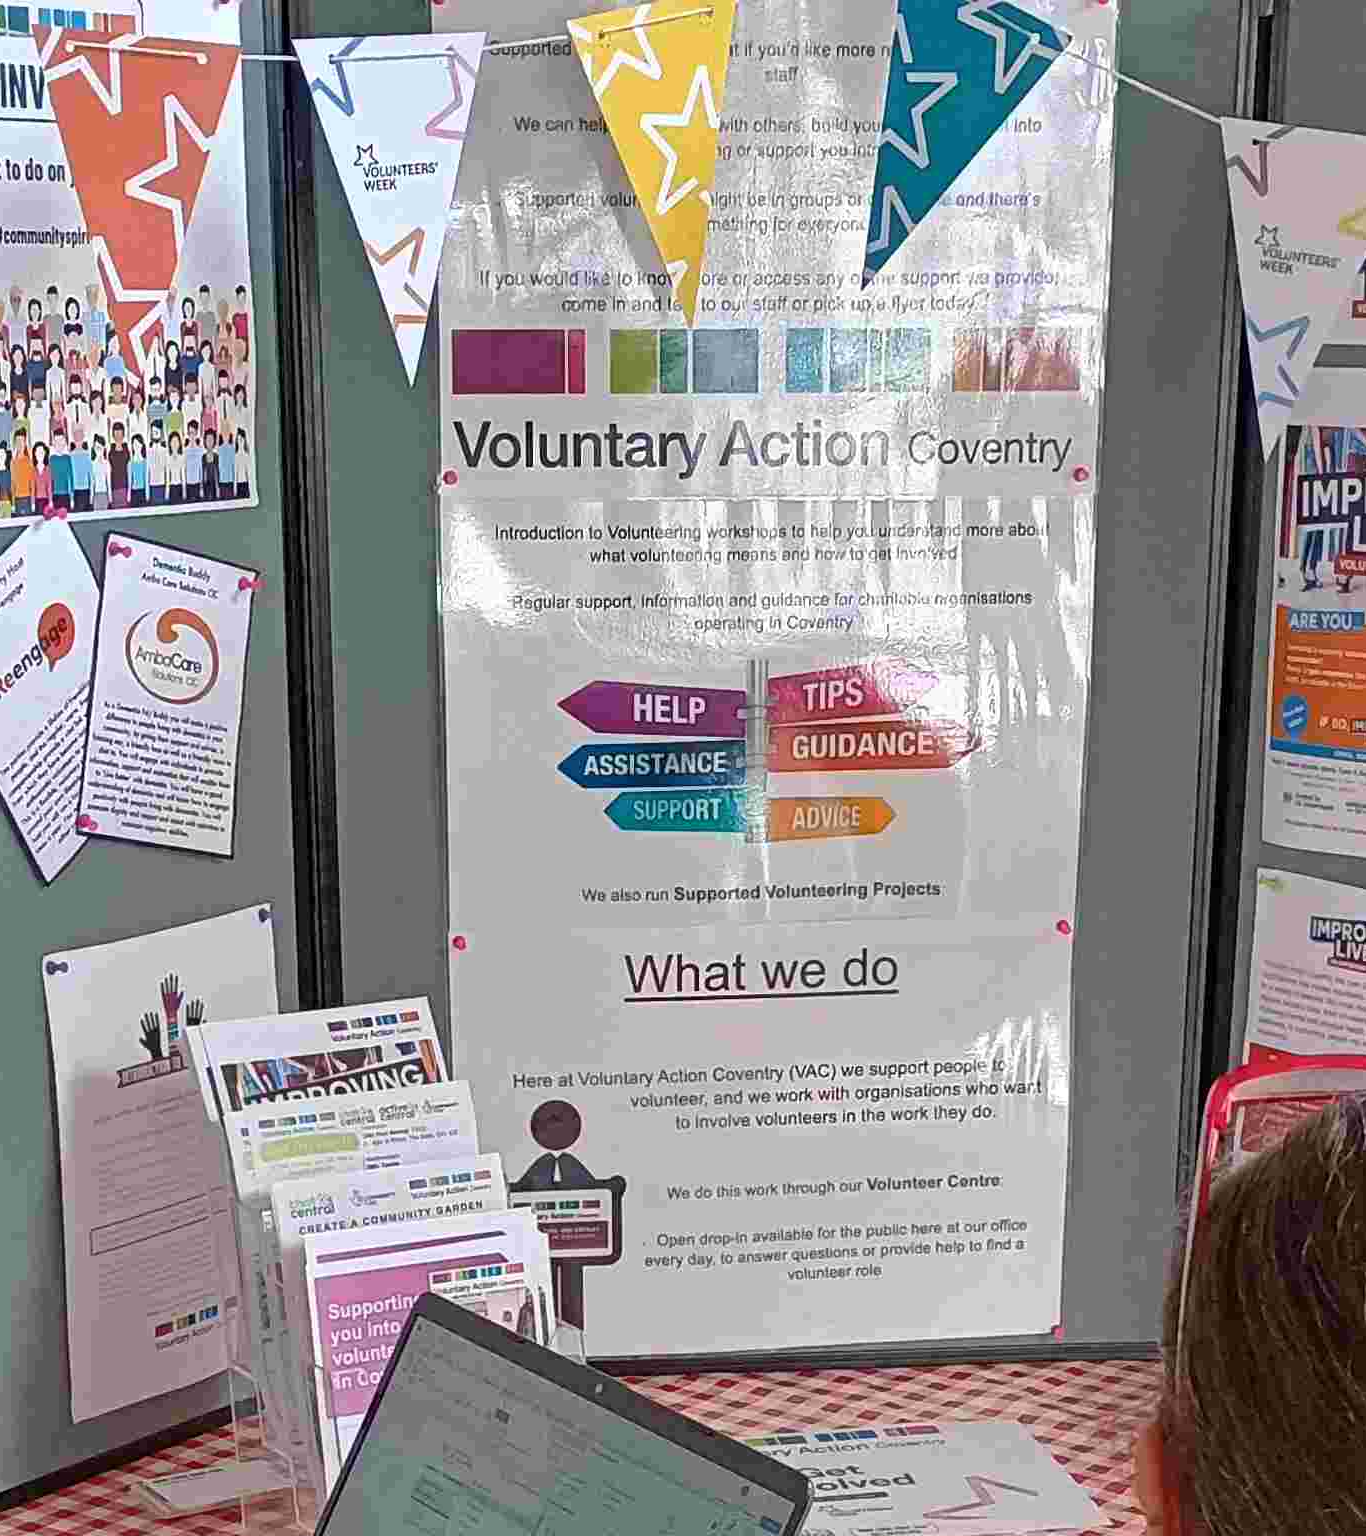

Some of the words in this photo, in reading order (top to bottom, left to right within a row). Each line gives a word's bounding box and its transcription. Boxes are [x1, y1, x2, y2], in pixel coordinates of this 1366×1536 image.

[514, 117, 540, 132] We
[545, 120, 574, 132] can
[6, 158, 21, 181] to
[25, 158, 44, 182] do
[452, 420, 707, 481] Voluntary
[718, 419, 889, 468] Action
[907, 429, 1072, 474] Coventry
[495, 524, 584, 541] Introduction
[588, 526, 603, 541] to
[607, 525, 701, 543] Volunteering
[791, 523, 806, 538] to
[966, 524, 1004, 538] more
[589, 548, 626, 563] what
[802, 678, 865, 713] TIPS
[633, 692, 707, 726] HELP
[791, 731, 937, 761] GUIDANCE
[583, 751, 728, 777] ASSISTANCE
[633, 798, 723, 822] SUPPORT
[792, 805, 862, 831] ADVICE
[673, 885, 760, 904] Supported
[765, 882, 868, 902] Volunteering
[624, 951, 747, 994] What
[761, 957, 828, 992] we
[842, 946, 900, 988] do
[513, 1072, 554, 1089] Here
[557, 1072, 574, 1087] at
[579, 1070, 653, 1089] Voluntary
[657, 1068, 708, 1085] Action
[712, 1066, 784, 1085] Coventry
[788, 1062, 837, 1081] (VAC)
[841, 1064, 864, 1077] we
[868, 1058, 929, 1080] support
[713, 1089, 744, 1105] and
[748, 1091, 772, 1104] we
[775, 1088, 814, 1103] work
[818, 1085, 850, 1101] with
[854, 1081, 962, 1102] organisations
[965, 1079, 999, 1096] who
[675, 1114, 691, 1130] to
[695, 1112, 751, 1129] involve
[755, 1109, 837, 1127] volunteers
[841, 1108, 857, 1123] in
[861, 1107, 886, 1123] the
[890, 1105, 929, 1122] work
[933, 1103, 967, 1123] they
[666, 1186, 690, 1200] We
[694, 1184, 713, 1199] do
[717, 1183, 741, 1198] this
[745, 1182, 778, 1198] work
[782, 1179, 836, 1197] through
[839, 1181, 863, 1194] our
[866, 1174, 944, 1192] Volunteer
[435, 1200, 484, 1216] GARDEN
[656, 1232, 696, 1249] Open
[751, 1227, 814, 1244] available
[817, 1225, 836, 1240] for
[840, 1224, 863, 1239] the
[865, 1222, 909, 1240] public
[910, 1221, 943, 1236] here
[964, 1221, 988, 1234] our
[990, 1218, 1029, 1233] office
[644, 1253, 684, 1270] every
[720, 1250, 734, 1266] to
[737, 1249, 788, 1264] answer
[861, 1246, 877, 1259] or
[330, 1325, 362, 1347] you
